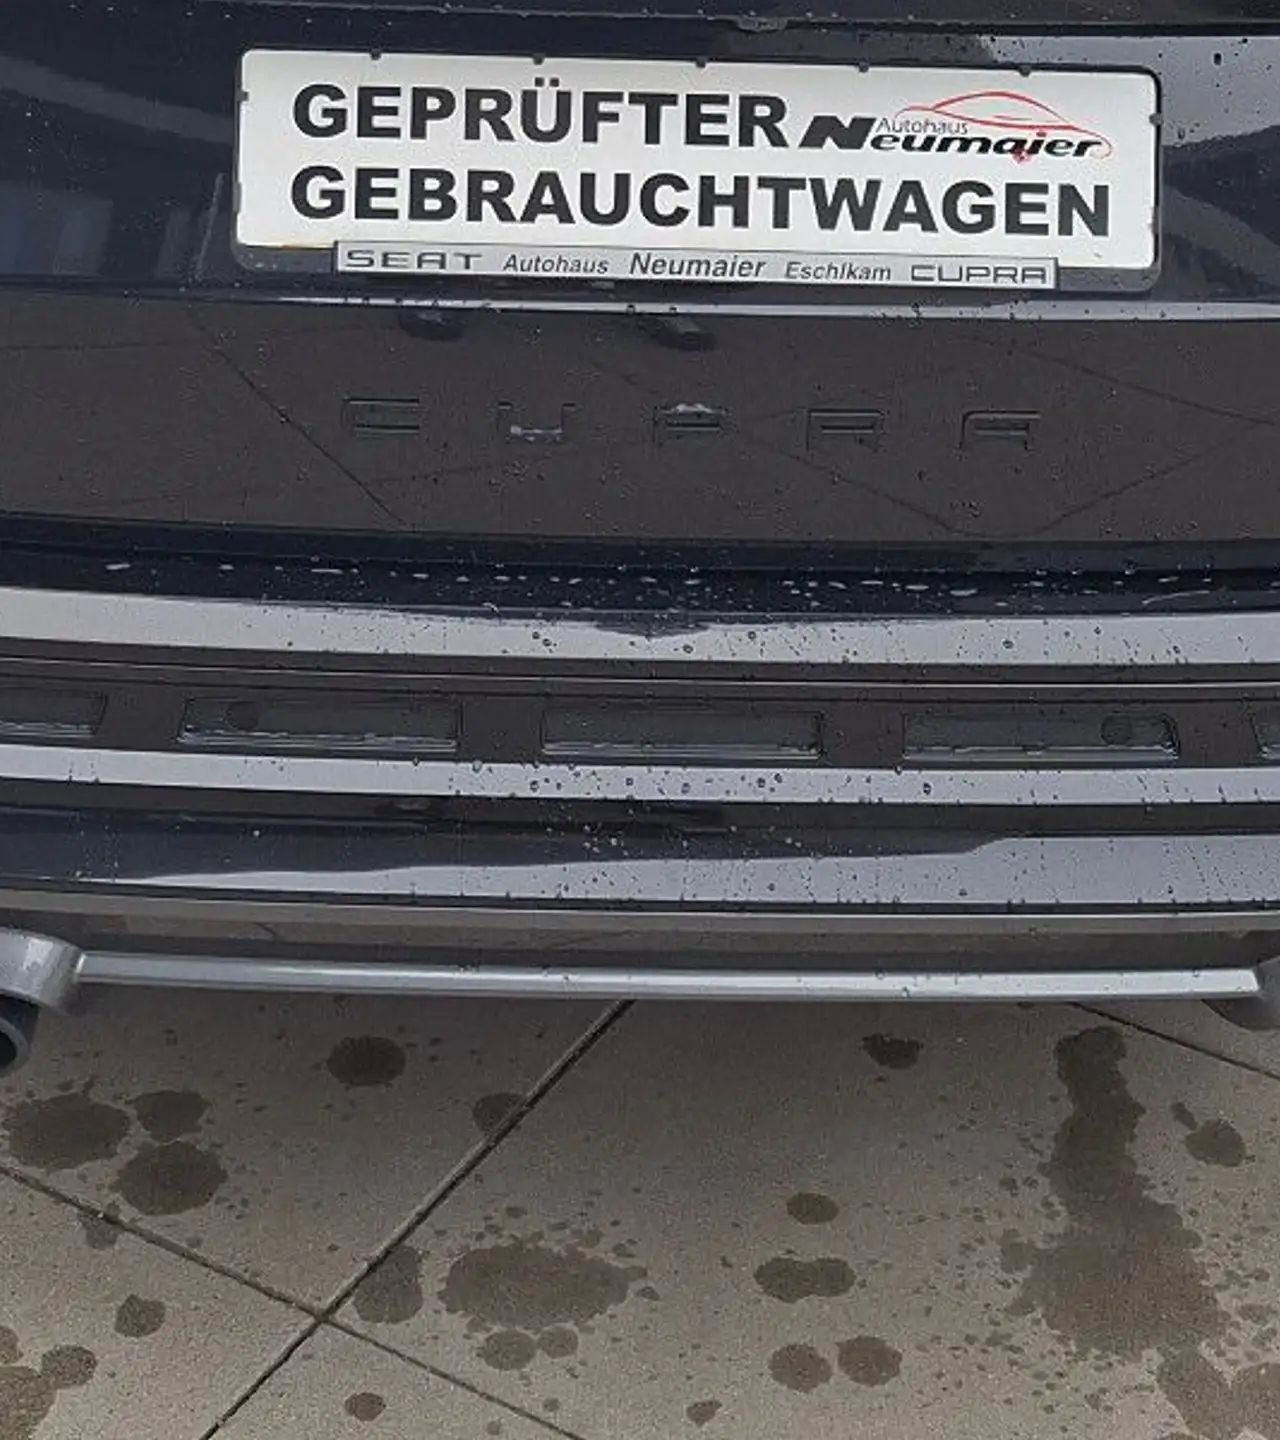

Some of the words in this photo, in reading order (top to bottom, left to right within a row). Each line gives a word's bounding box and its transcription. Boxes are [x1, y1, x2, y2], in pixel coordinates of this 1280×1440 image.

[292, 77, 788, 149] GEPRÜFTER
[875, 116, 968, 134] Autohaus
[798, 115, 1103, 159] Neumaier
[290, 166, 1111, 236] GEBRAUCHTWAGEN
[345, 249, 483, 271] SEAT
[503, 254, 610, 274] Autohaus
[629, 252, 766, 278] Neumaier
[910, 263, 1047, 284] CUPRA
